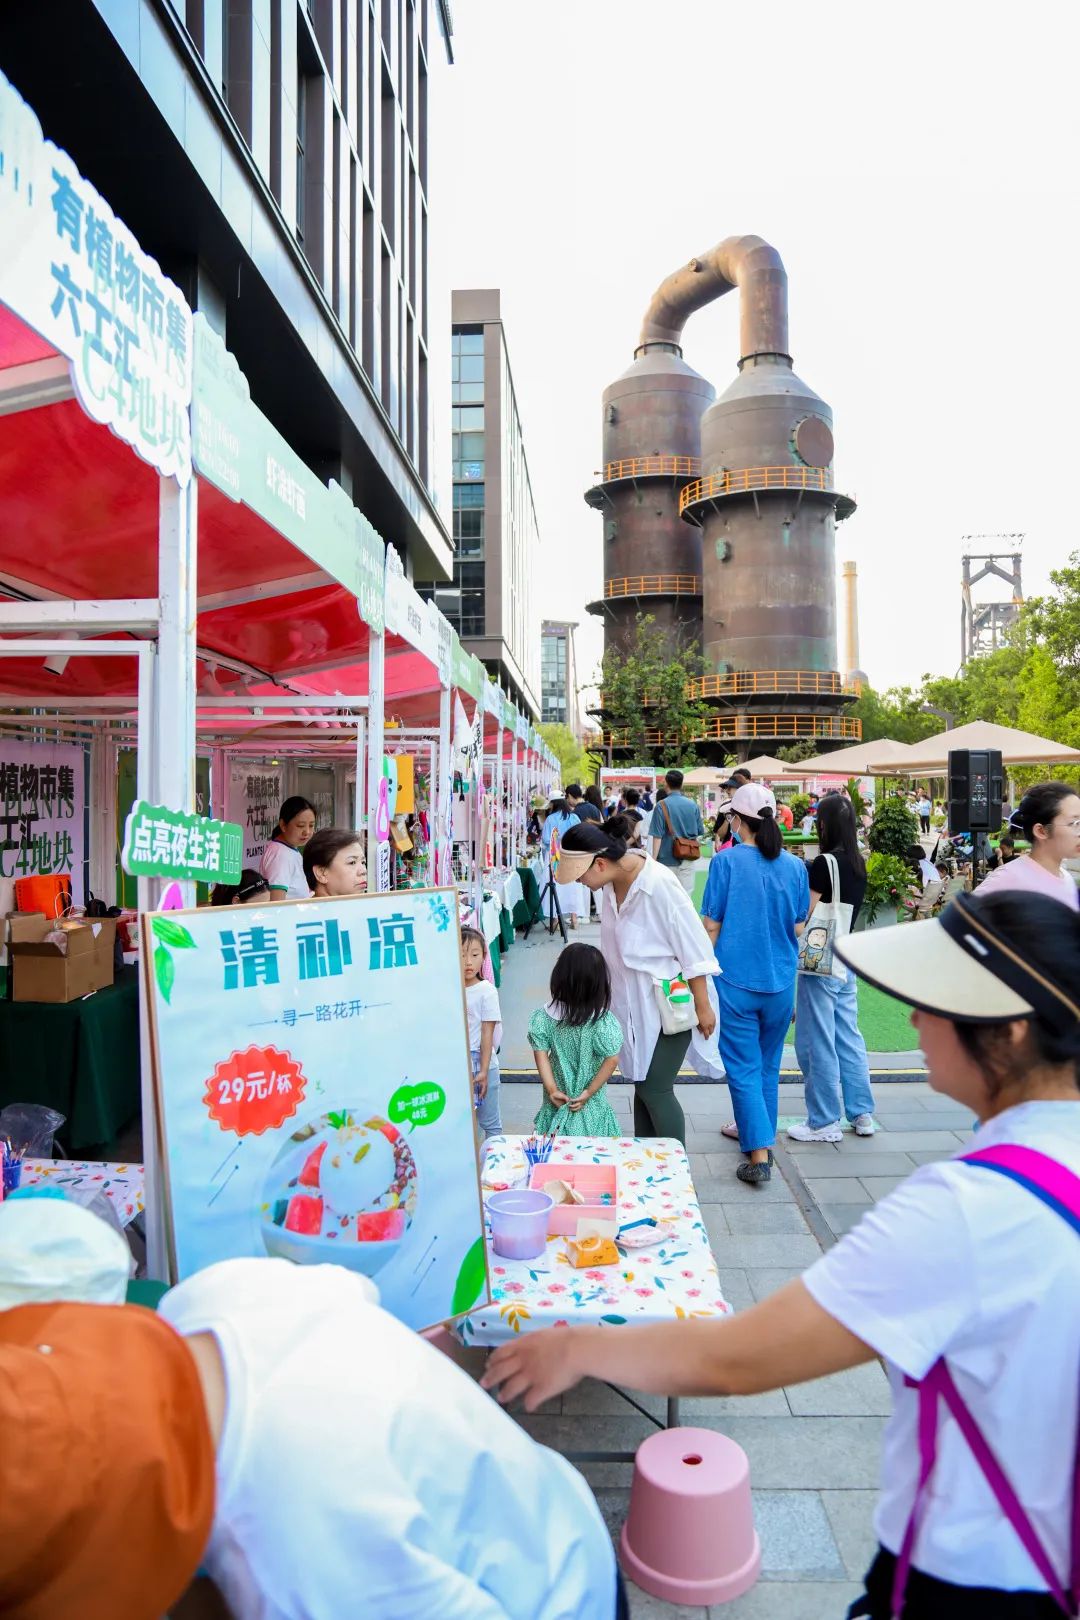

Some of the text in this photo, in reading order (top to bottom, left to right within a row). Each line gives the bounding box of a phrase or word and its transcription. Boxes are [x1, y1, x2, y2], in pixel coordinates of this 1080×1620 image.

[50, 166, 187, 361] 有植物市集
[50, 261, 141, 388] 六工汇
[82, 329, 187, 467] C4地块
[0, 762, 75, 801] 植物市集
[0, 830, 74, 878] C4地块
[218, 912, 419, 991] 清补凉
[282, 999, 363, 1028] 寻一路花开
[217, 1070, 293, 1105] 29元/杯
